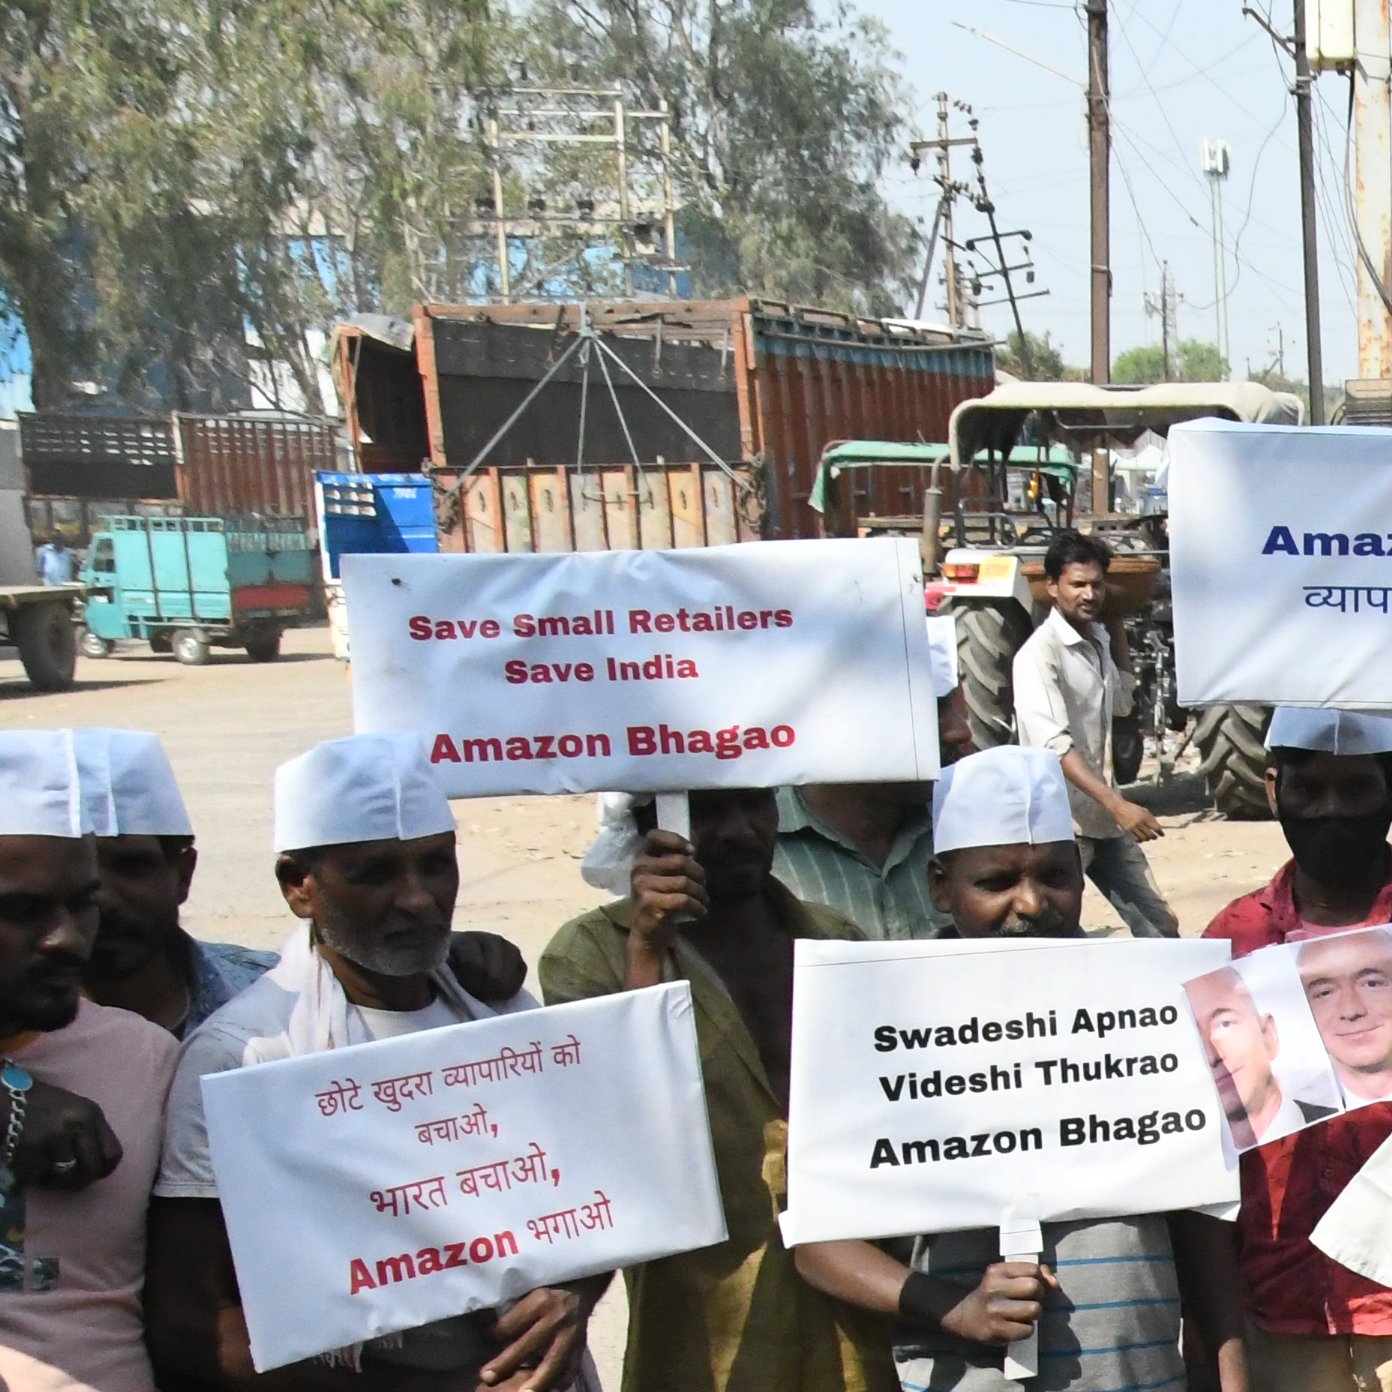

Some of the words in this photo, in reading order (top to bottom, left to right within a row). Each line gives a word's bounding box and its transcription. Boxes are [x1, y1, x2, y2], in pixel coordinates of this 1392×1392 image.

[409, 611, 500, 642] Save
[513, 608, 614, 637] Small
[629, 604, 794, 633] Retailers
[505, 657, 596, 685] Save
[607, 651, 698, 680] India
[430, 724, 611, 764] Amazon
[627, 722, 796, 761] Bhagao
[873, 1010, 1057, 1052] Swadeshi
[1071, 1004, 1178, 1038] Apnao
[315, 1078, 364, 1117] छोटे
[372, 1070, 433, 1111] खुदरा
[442, 1041, 543, 1088] व्यापारियों
[551, 1034, 581, 1067] को
[879, 1062, 1023, 1102] Videshi
[1035, 1052, 1179, 1087] Thukrao
[415, 1102, 499, 1146] बचाओ,
[869, 1127, 1043, 1169] Amazon
[1059, 1108, 1207, 1147] Bhagao
[369, 1175, 447, 1218] भारत
[456, 1142, 561, 1197] बचाओ,
[350, 1227, 518, 1295] Amazon
[526, 1191, 614, 1246] भगाओ
